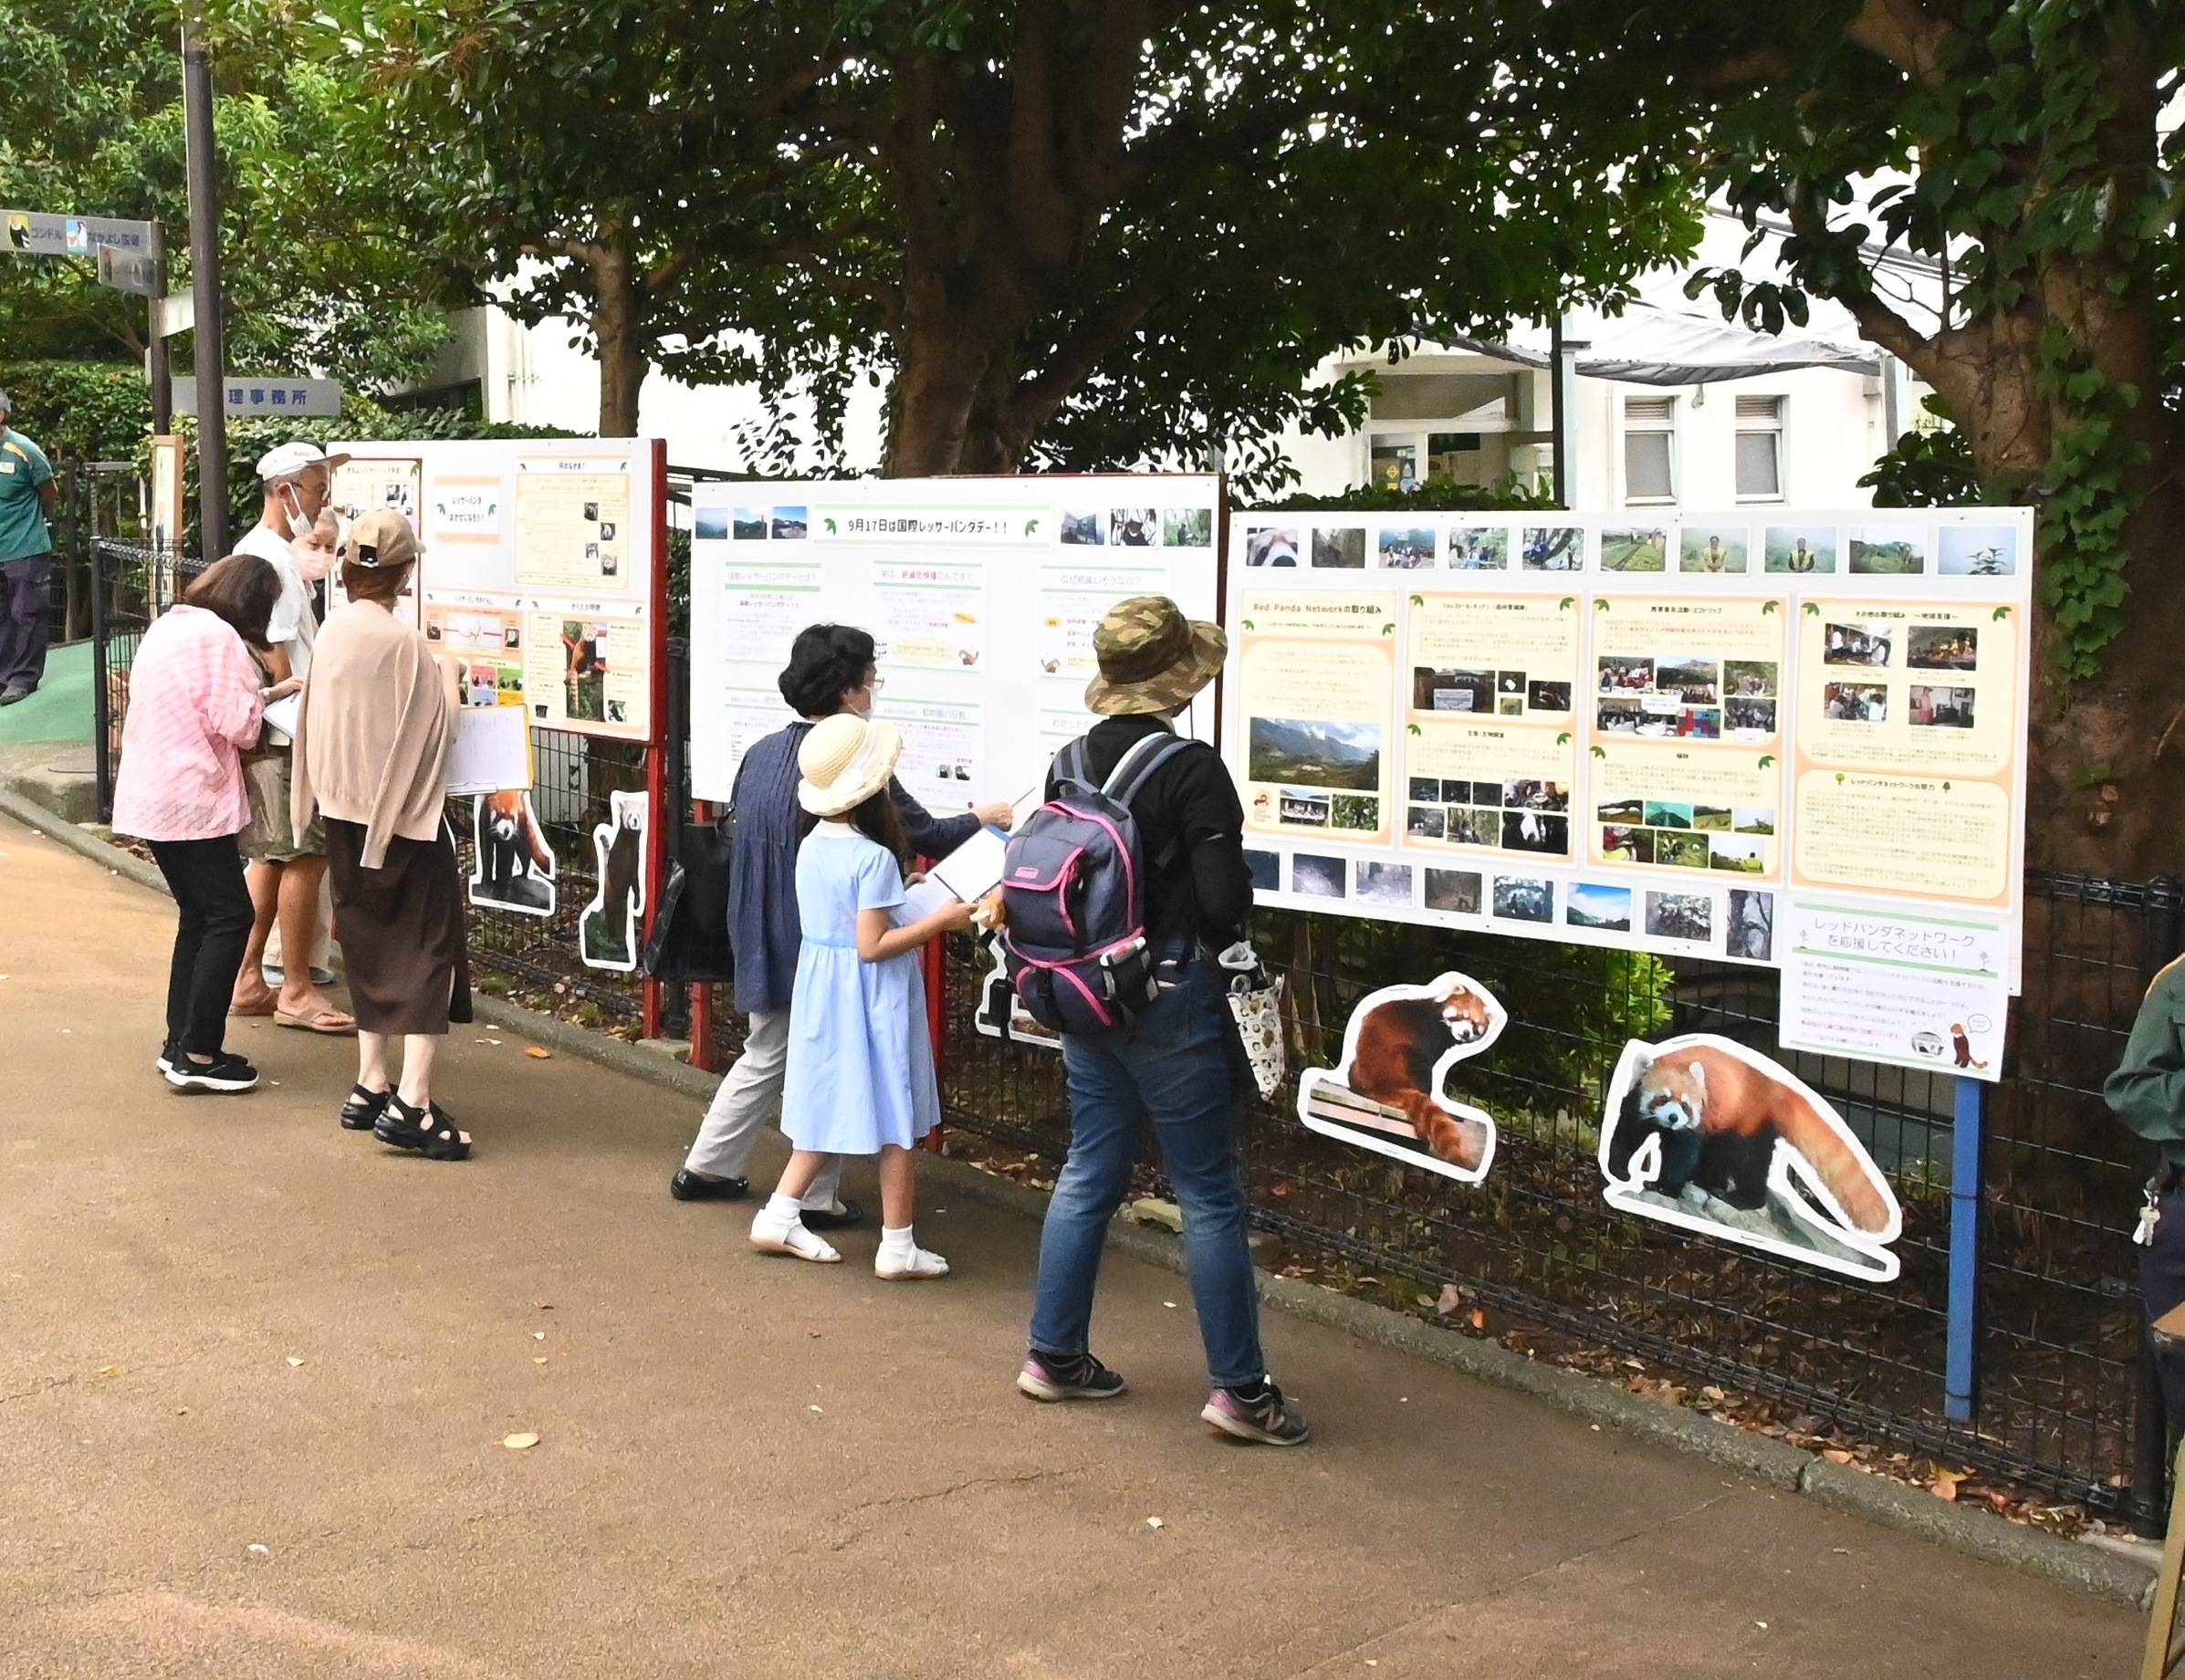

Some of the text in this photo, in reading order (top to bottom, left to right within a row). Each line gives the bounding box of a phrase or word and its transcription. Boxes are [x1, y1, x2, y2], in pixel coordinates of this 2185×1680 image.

[228, 389, 307, 405] 理事務所
[848, 518, 1007, 534] 9月17日は国際レッサーパンダデー！！
[1253, 603, 1382, 614] Red Panda Networkの取り組み
[1814, 918, 1975, 947] レッドパンダネットワーク
[1827, 934, 1957, 959] を応援してください！
